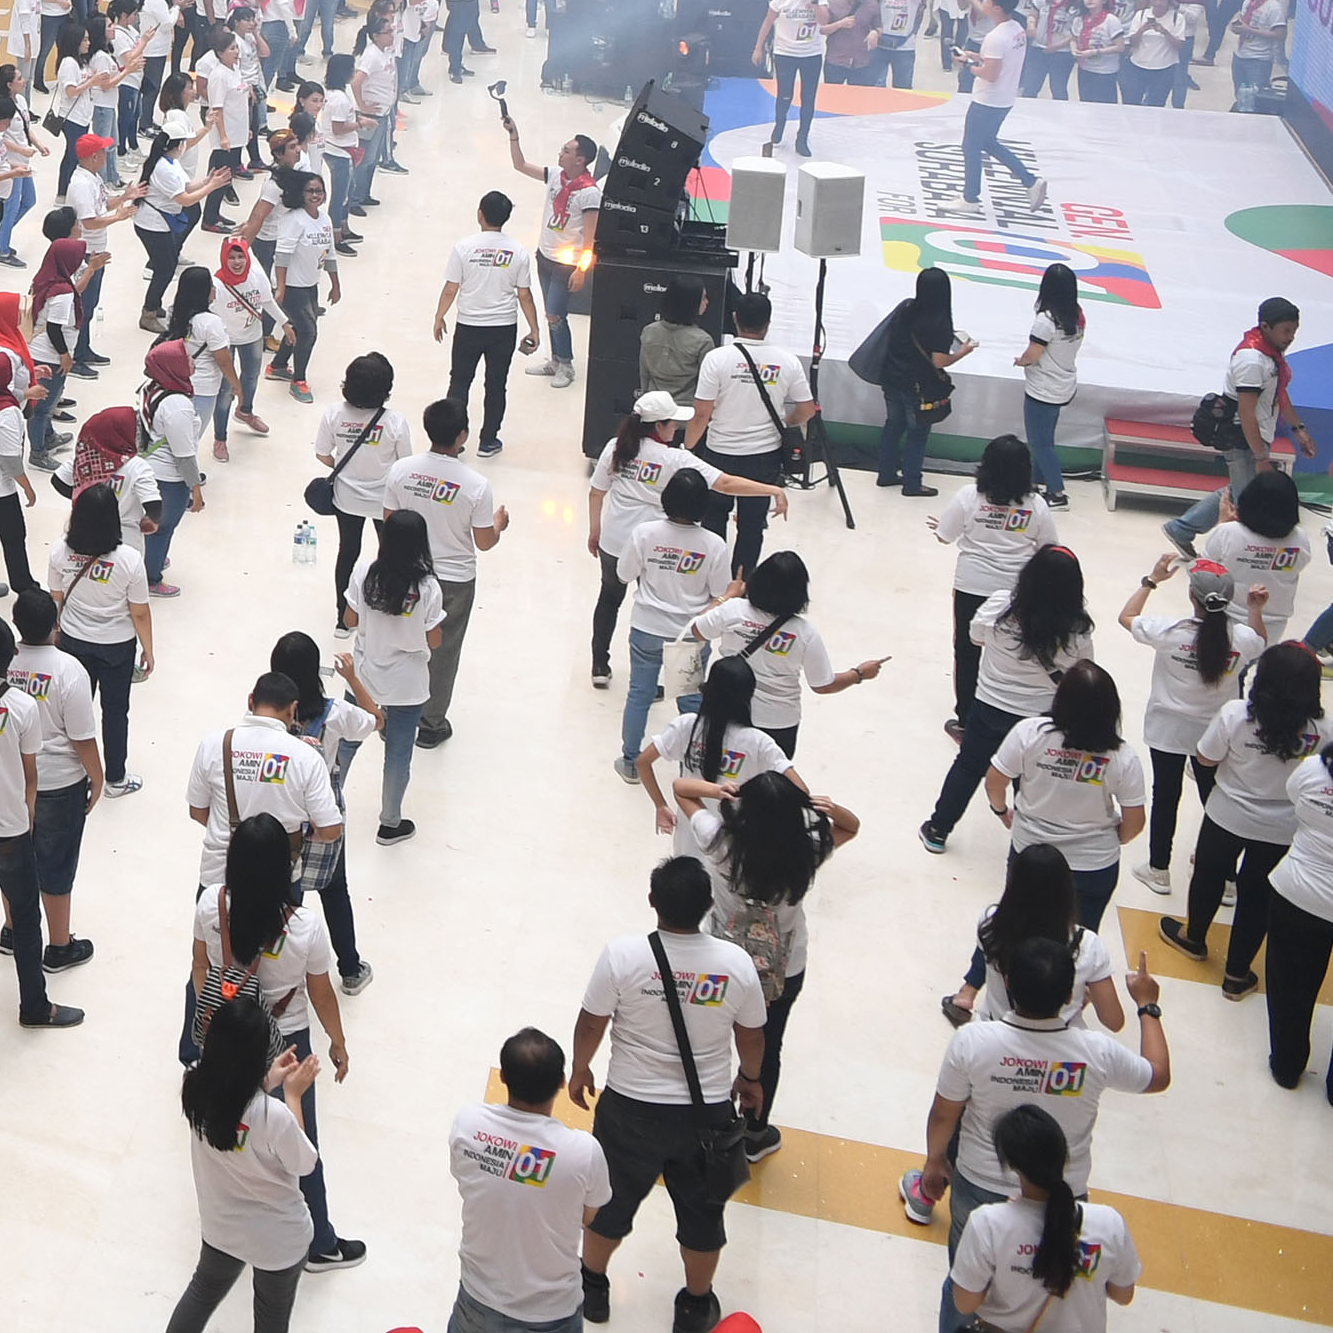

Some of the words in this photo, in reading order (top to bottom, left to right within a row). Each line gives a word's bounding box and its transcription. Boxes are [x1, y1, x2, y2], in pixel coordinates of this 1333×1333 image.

[799, 24, 814, 40] 01
[653, 177, 661, 187] 2
[877, 189, 917, 215] FOR
[639, 224, 649, 234] 13
[1061, 201, 1134, 241] GEN.
[473, 248, 496, 256] JOKOWI
[495, 251, 513, 268] 01
[760, 368, 779, 383] 01
[409, 473, 438, 483] JOKOWI
[640, 464, 661, 482] 01
[417, 480, 436, 488] AMIN
[435, 482, 456, 502] 01
[978, 505, 1009, 514] JOKOWI
[1009, 512, 1030, 531] 01
[652, 545, 683, 555] JOKOWI
[1245, 545, 1280, 554] JOKOWI
[680, 553, 702, 573] 01
[1275, 550, 1299, 570] 01
[92, 561, 112, 579] 01
[772, 632, 793, 653] 01
[32, 676, 51, 698] 01
[1044, 748, 1082, 759] JOKOWI
[239, 758, 261, 767] AMIN
[263, 757, 286, 781] 01
[1055, 757, 1079, 767] AMIN
[1078, 757, 1106, 783] 01
[236, 774, 255, 782] MAJU
[695, 976, 728, 1004] 01
[999, 1057, 1048, 1069] JOKOWI
[1015, 1067, 1046, 1077] AMIN
[1048, 1066, 1084, 1094] 01
[989, 1075, 1045, 1086] INDONESIA
[1012, 1083, 1039, 1093] MAJU
[472, 1130, 519, 1150] JOKOWI
[463, 1148, 505, 1168] INDONESIA
[483, 1144, 514, 1159] AMIN
[481, 1161, 504, 1178] MAJU
[513, 1144, 553, 1185] 01
